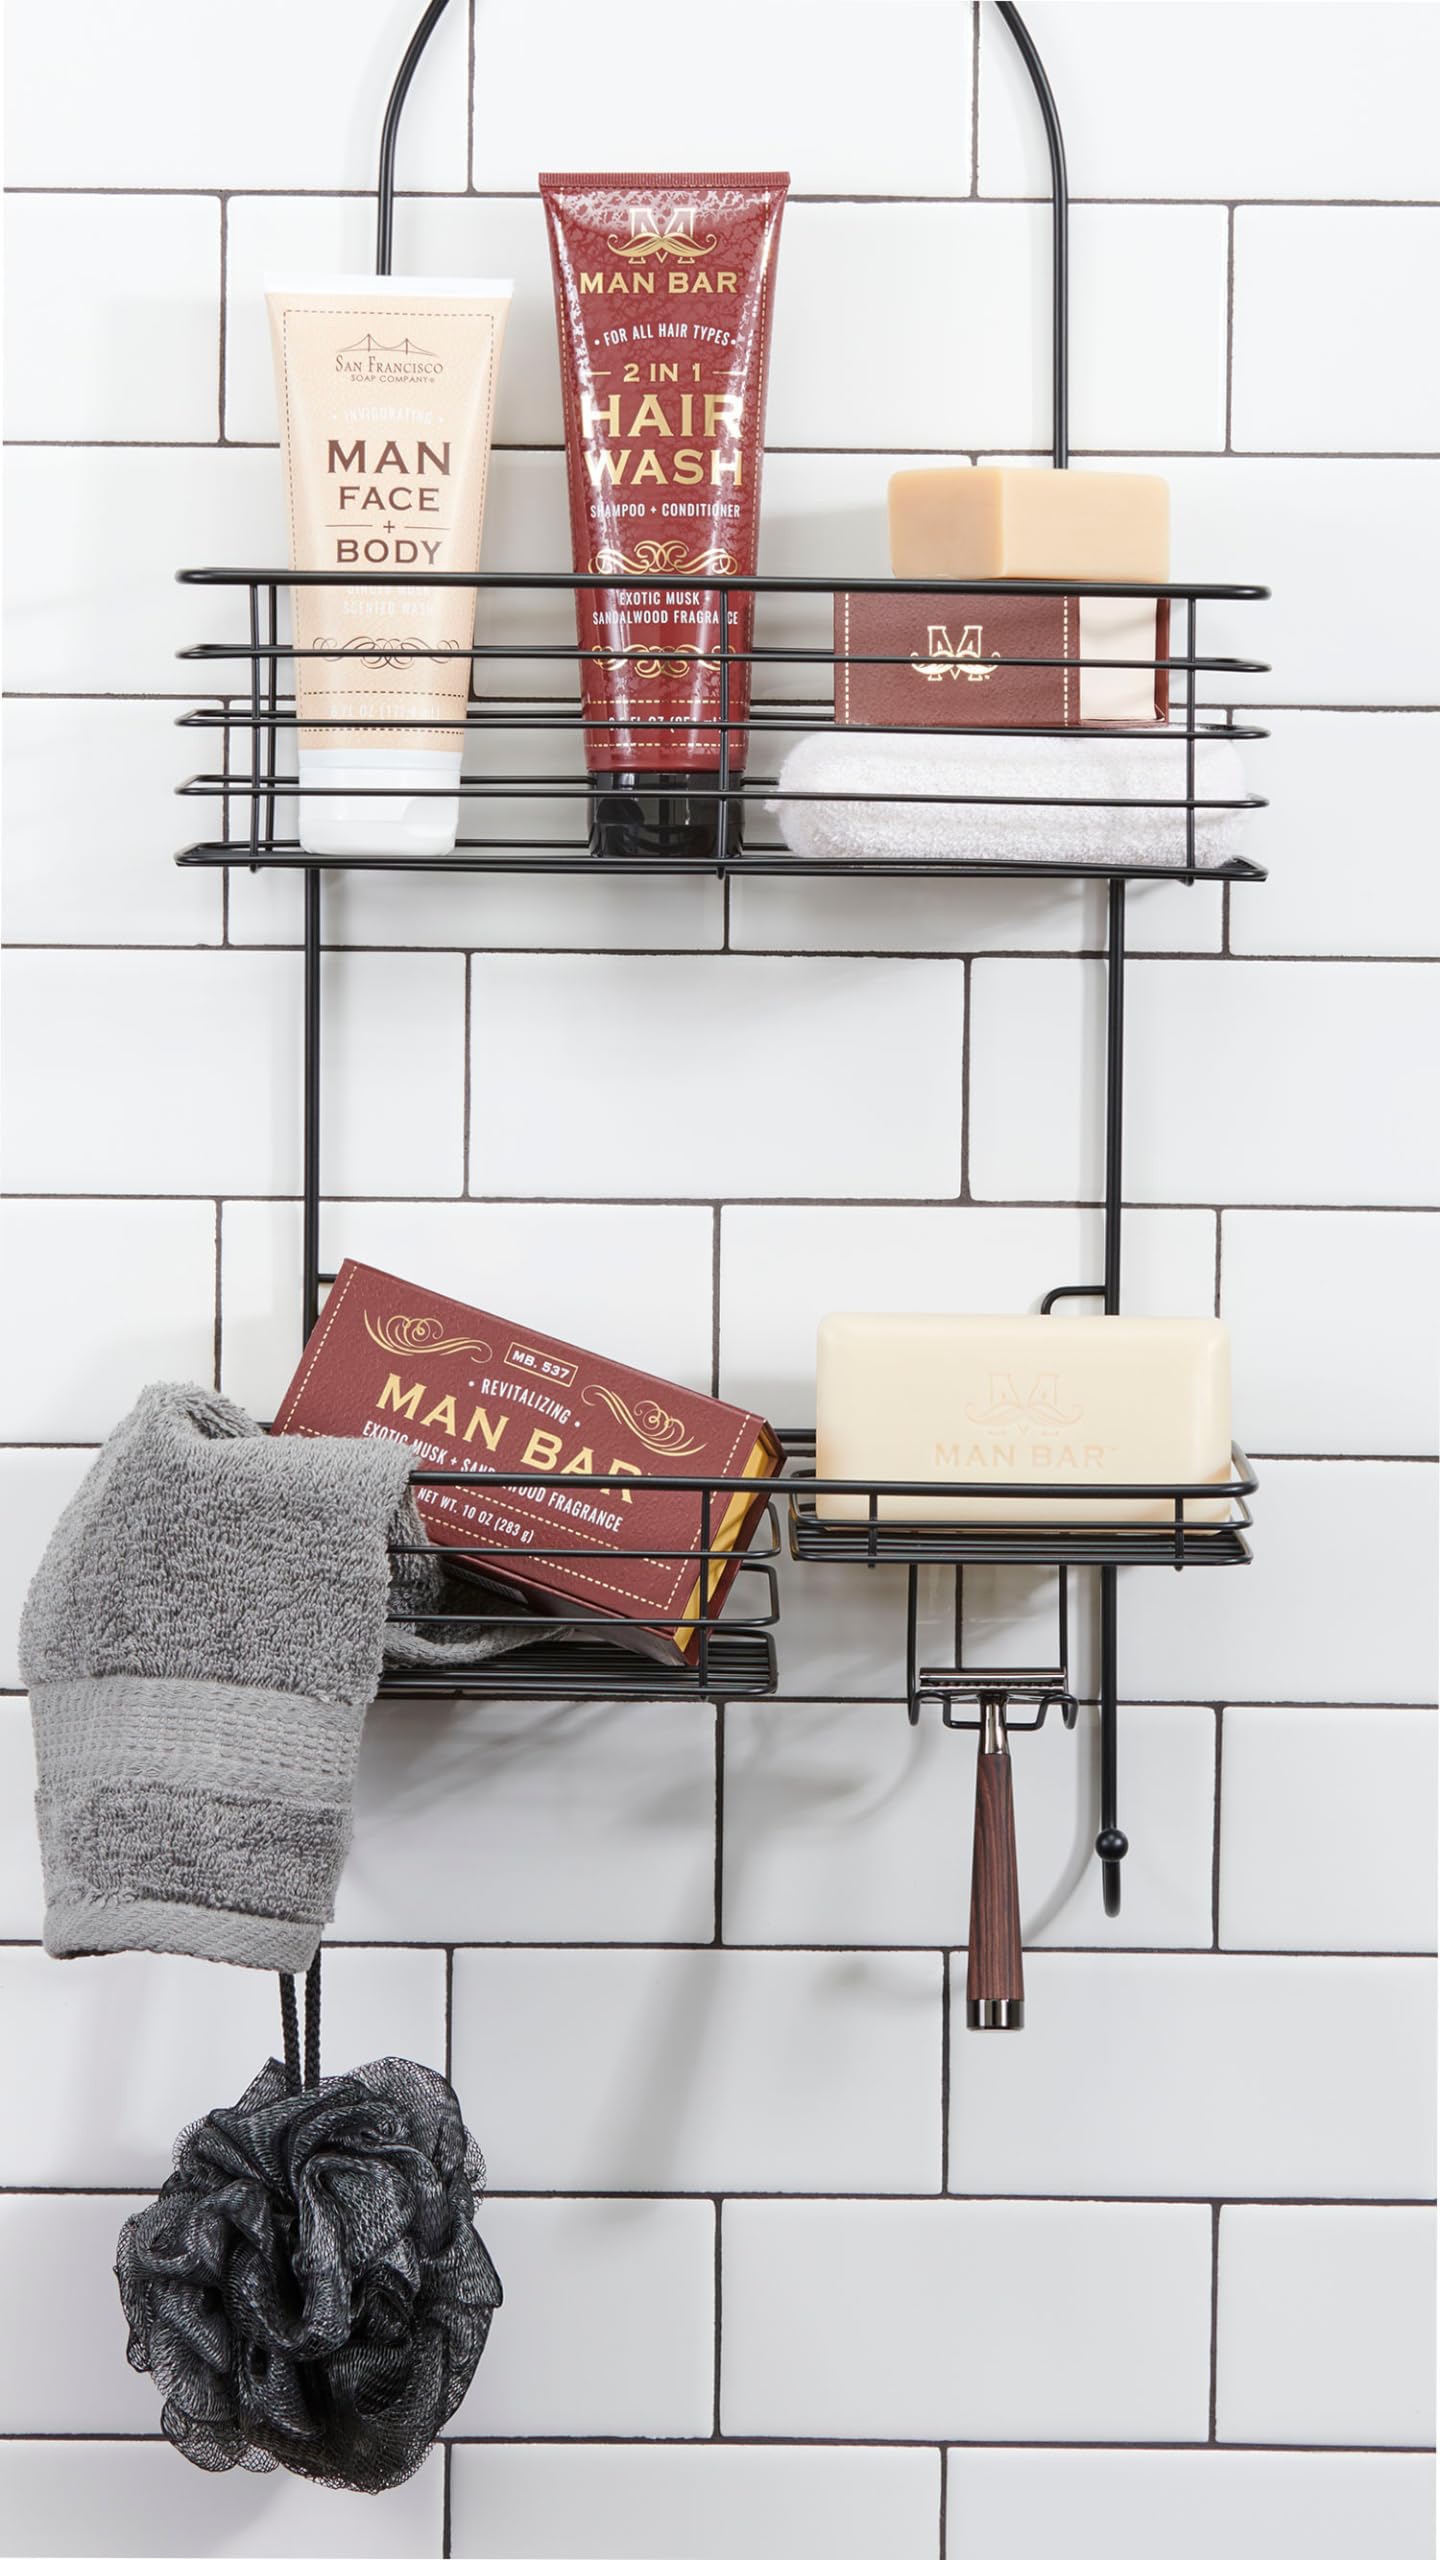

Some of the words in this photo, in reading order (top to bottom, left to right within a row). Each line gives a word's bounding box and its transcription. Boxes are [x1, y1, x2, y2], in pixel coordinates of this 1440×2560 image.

[579, 271, 655, 295] MAN
[668, 271, 738, 295] BAR
[603, 327, 628, 348] FOR
[632, 324, 654, 340] ALL
[658, 322, 689, 339] HAIR
[693, 324, 731, 347] TYPES
[335, 353, 362, 373] SAN
[368, 355, 444, 375] FRANCISCO
[623, 362, 641, 383] 2
[649, 362, 679, 383] IN
[692, 362, 701, 383] 1
[350, 374, 376, 383] SOAP
[580, 393, 744, 439] HAIR
[327, 439, 452, 476] MAN
[582, 448, 744, 486] WASH
[338, 485, 440, 513] FACE
[590, 503, 646, 519] SHAMPOO
[661, 502, 741, 518] CONDITIONER
[336, 538, 443, 567] BODY
[618, 591, 661, 606] EXOTIC
[665, 591, 700, 606] MUSK
[592, 609, 668, 625] SANDALWOOD
[673, 609, 739, 625] FRAGRACE
[512, 1350, 538, 1369] MB.
[541, 1361, 571, 1379] 537
[375, 1372, 510, 1453] MAN
[481, 1378, 572, 1425] REVITALIZING
[933, 1442, 1017, 1468] MAN
[1031, 1443, 1106, 1469] BAR
[411, 1438, 448, 1466] MUSK
[547, 1491, 624, 1533] FRAGRANCE
[417, 1487, 439, 1505] NET
[440, 1495, 458, 1514] WT.
[462, 1504, 477, 1520] 10
[478, 1510, 494, 1527] OZ
[493, 1516, 521, 1537] (283
[520, 1529, 535, 1544] g)
